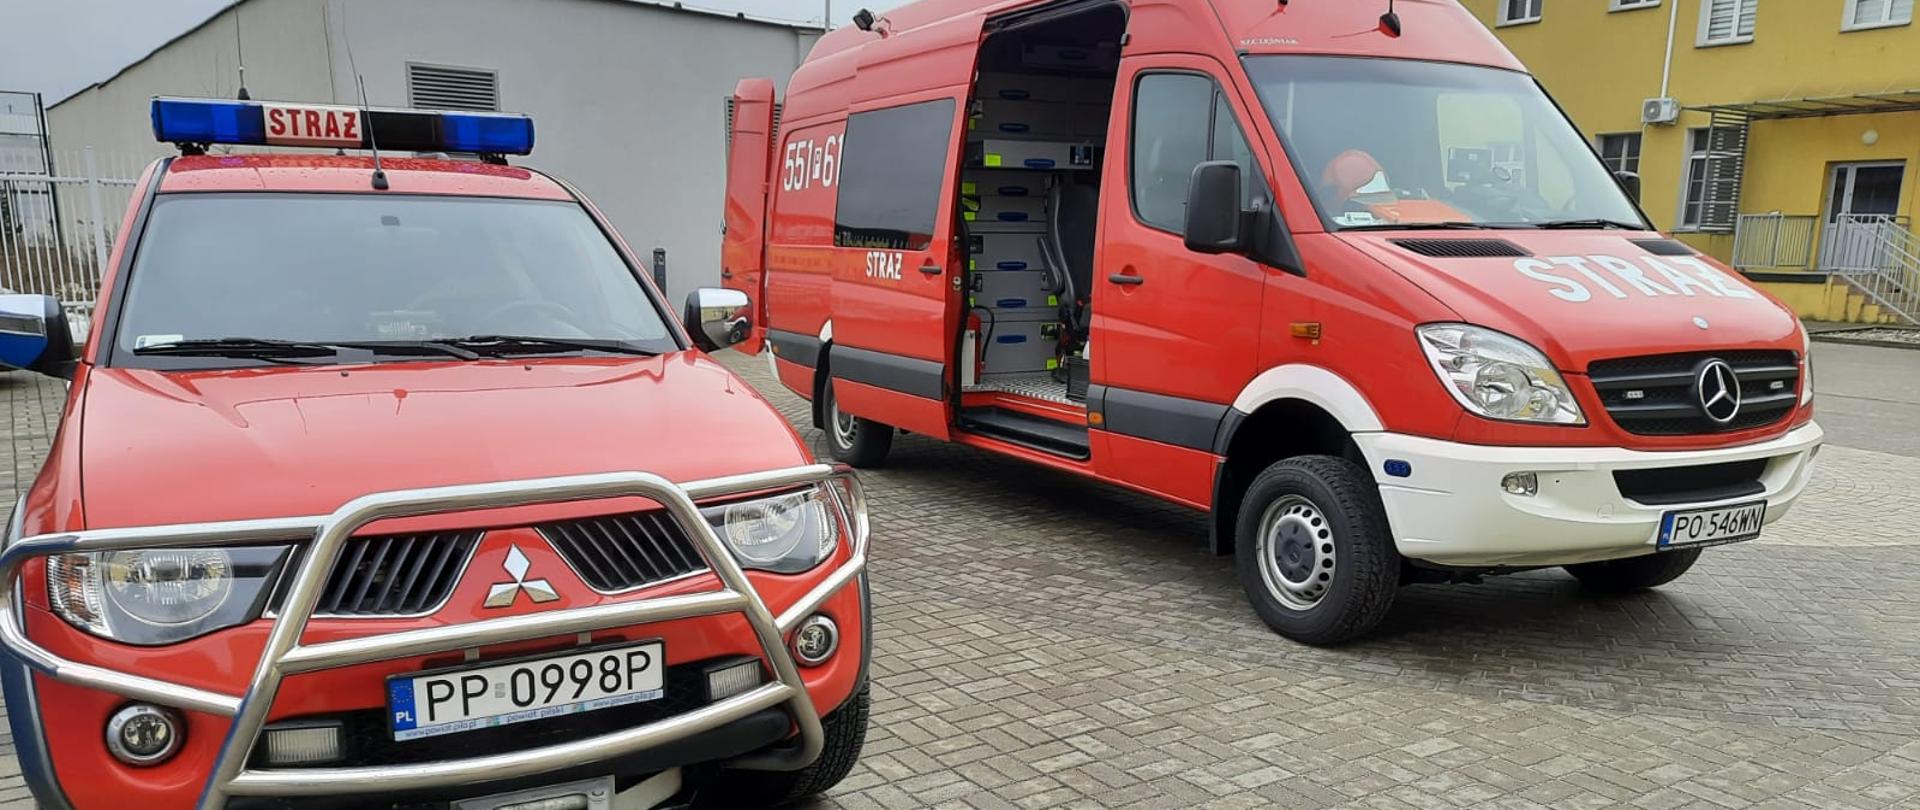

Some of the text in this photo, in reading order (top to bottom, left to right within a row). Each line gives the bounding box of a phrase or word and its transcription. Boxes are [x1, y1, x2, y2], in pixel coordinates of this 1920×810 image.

[269, 108, 357, 138] STRAŻ
[866, 251, 903, 280] STRAŻ
[1513, 255, 1756, 302] STRAŻ
[1673, 507, 1762, 540] PO 546WN
[426, 650, 652, 721] PP 0998P
[395, 710, 414, 723] PL
